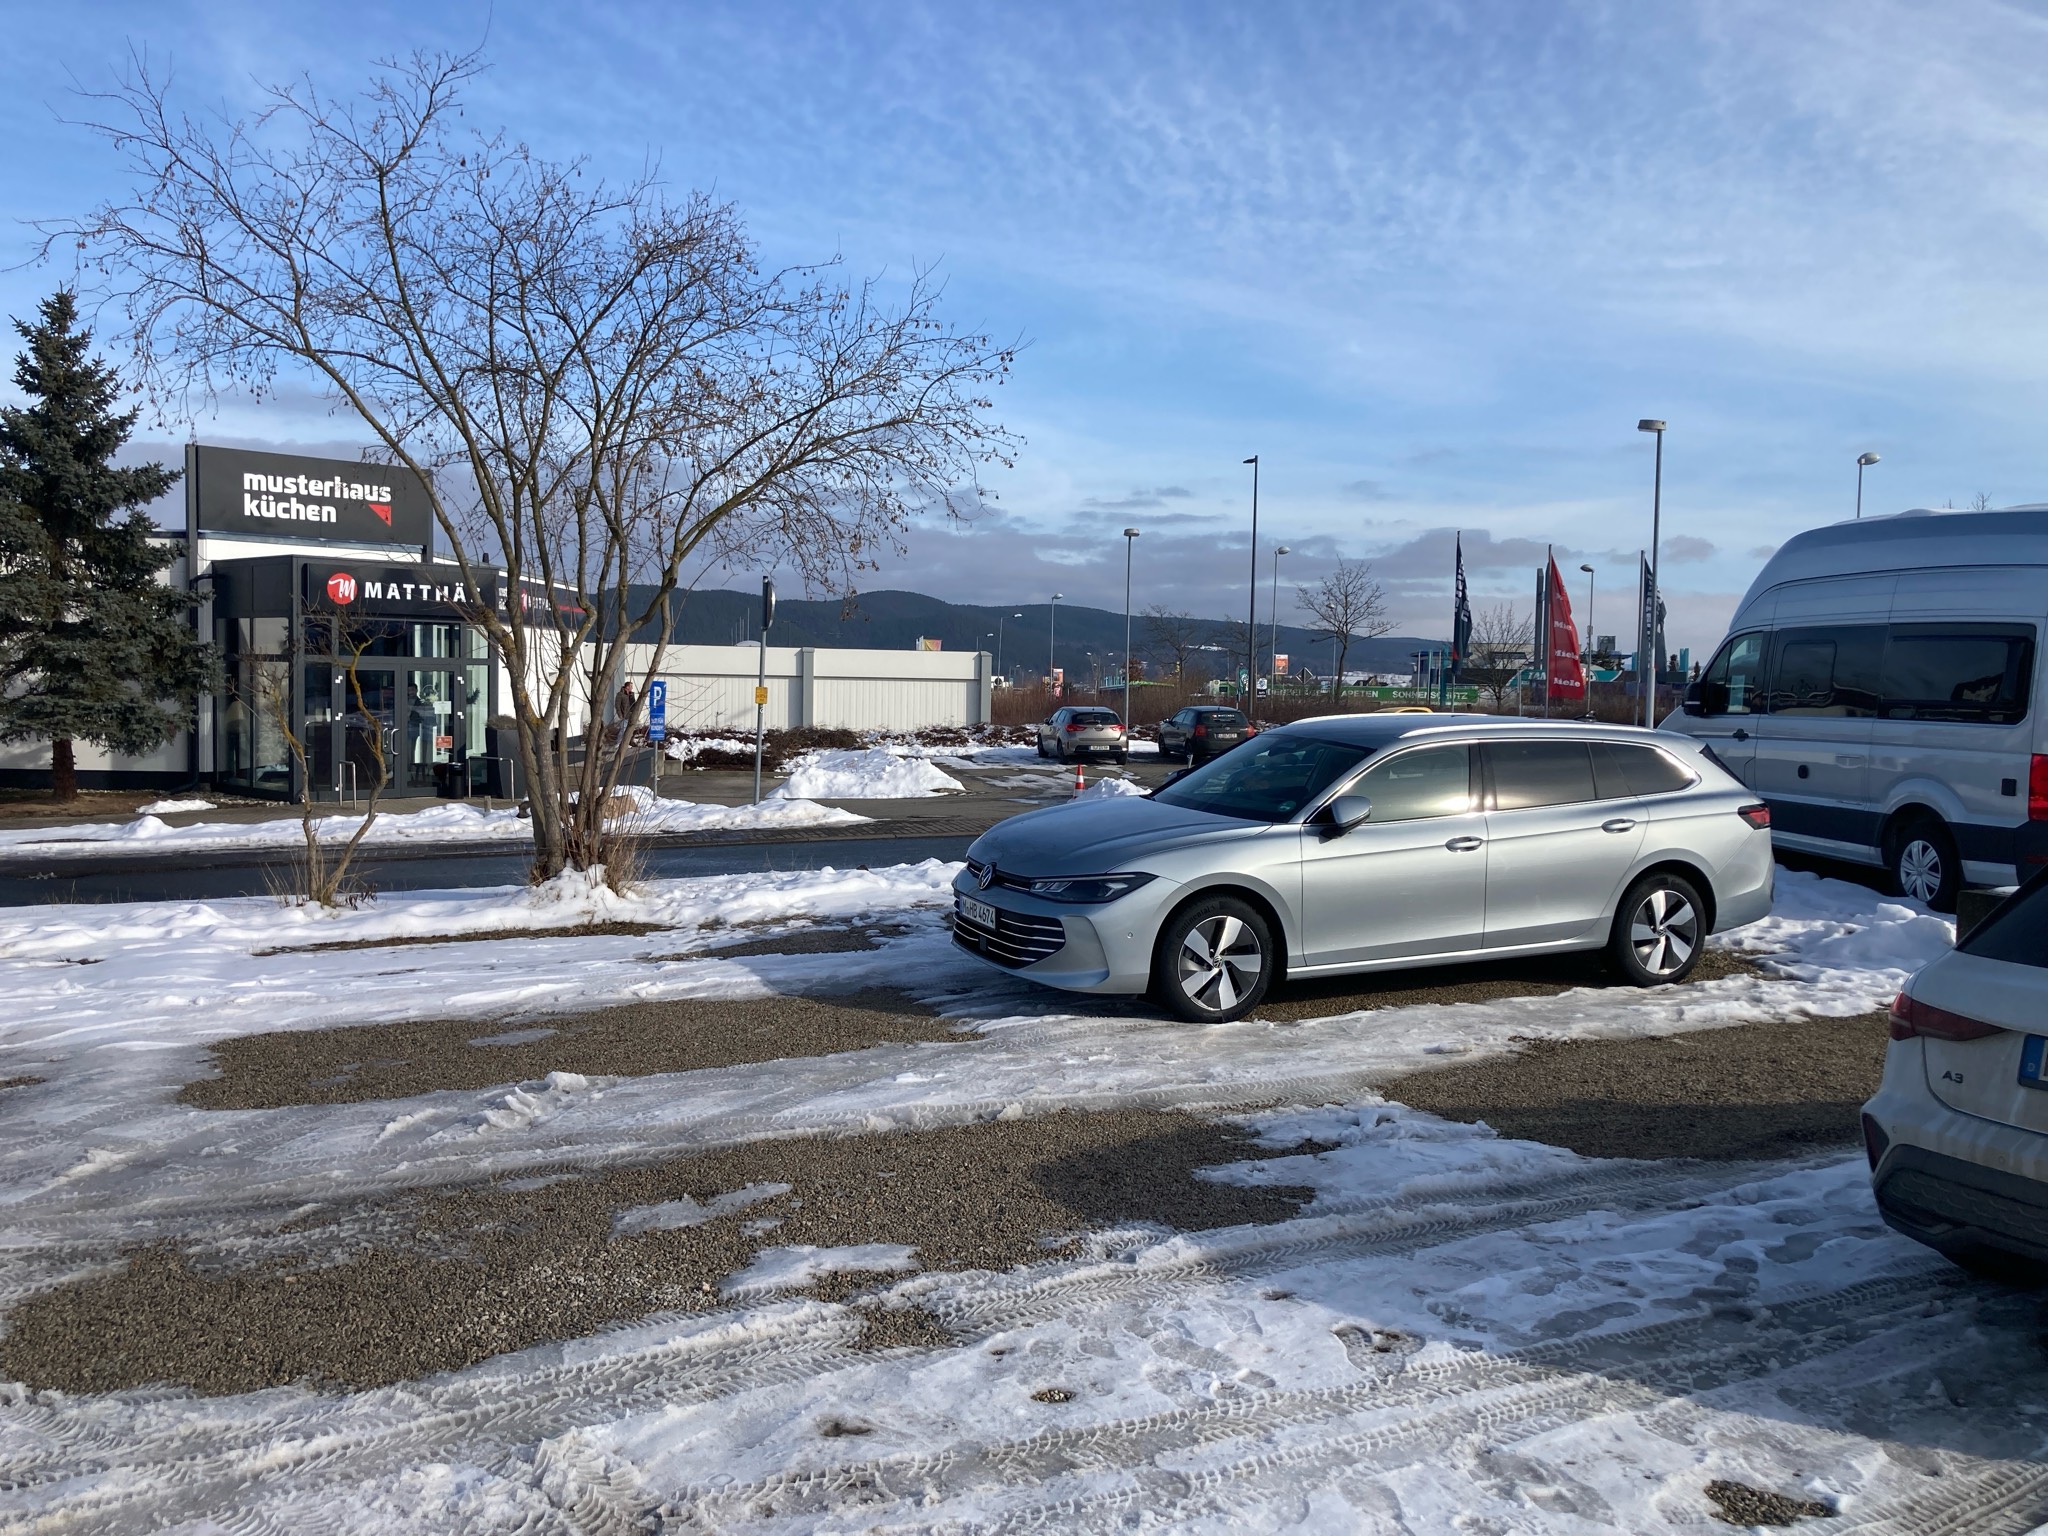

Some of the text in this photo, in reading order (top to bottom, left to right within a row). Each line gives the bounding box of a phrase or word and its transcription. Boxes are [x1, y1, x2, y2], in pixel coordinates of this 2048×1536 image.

[243, 473, 392, 503] musterhaus
[243, 493, 337, 524] küchen
[364, 581, 481, 603] MATTHÄ
[1553, 620, 1572, 631] Mie
[1553, 677, 1581, 688] Miele
[1338, 690, 1379, 699] APETEN
[1175, 905, 1212, 939] Continental
[2027, 1062, 2035, 1072] D
[1942, 1070, 1964, 1084] A3
